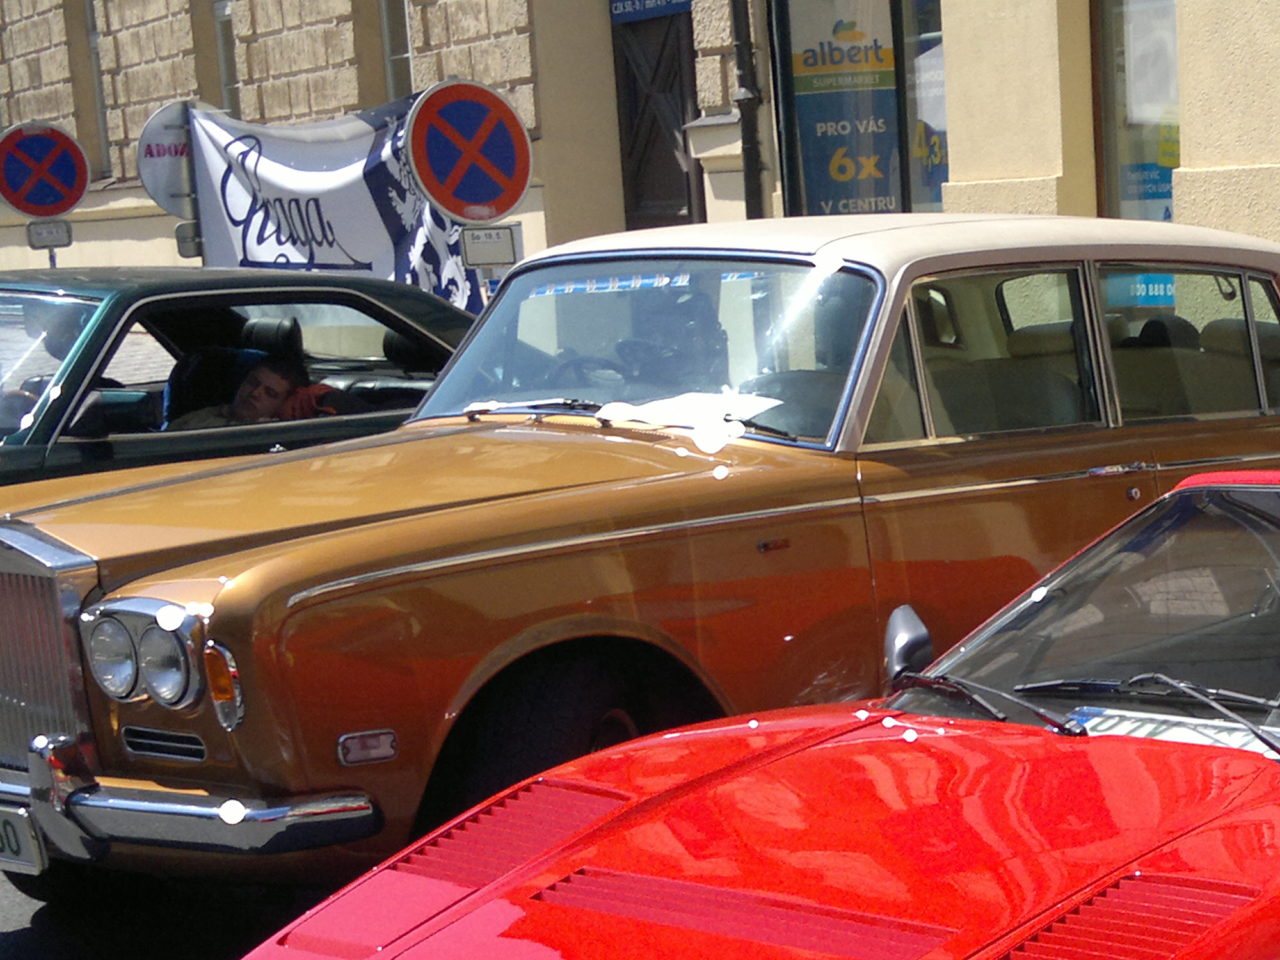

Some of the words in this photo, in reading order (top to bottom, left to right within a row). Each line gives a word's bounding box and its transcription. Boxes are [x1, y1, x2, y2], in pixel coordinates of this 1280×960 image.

[803, 39, 884, 68] albert
[816, 121, 851, 137] PRO
[855, 116, 887, 134] VÁS
[828, 147, 884, 182] 6x
[820, 200, 833, 214] V
[838, 196, 896, 214] CENTRU
